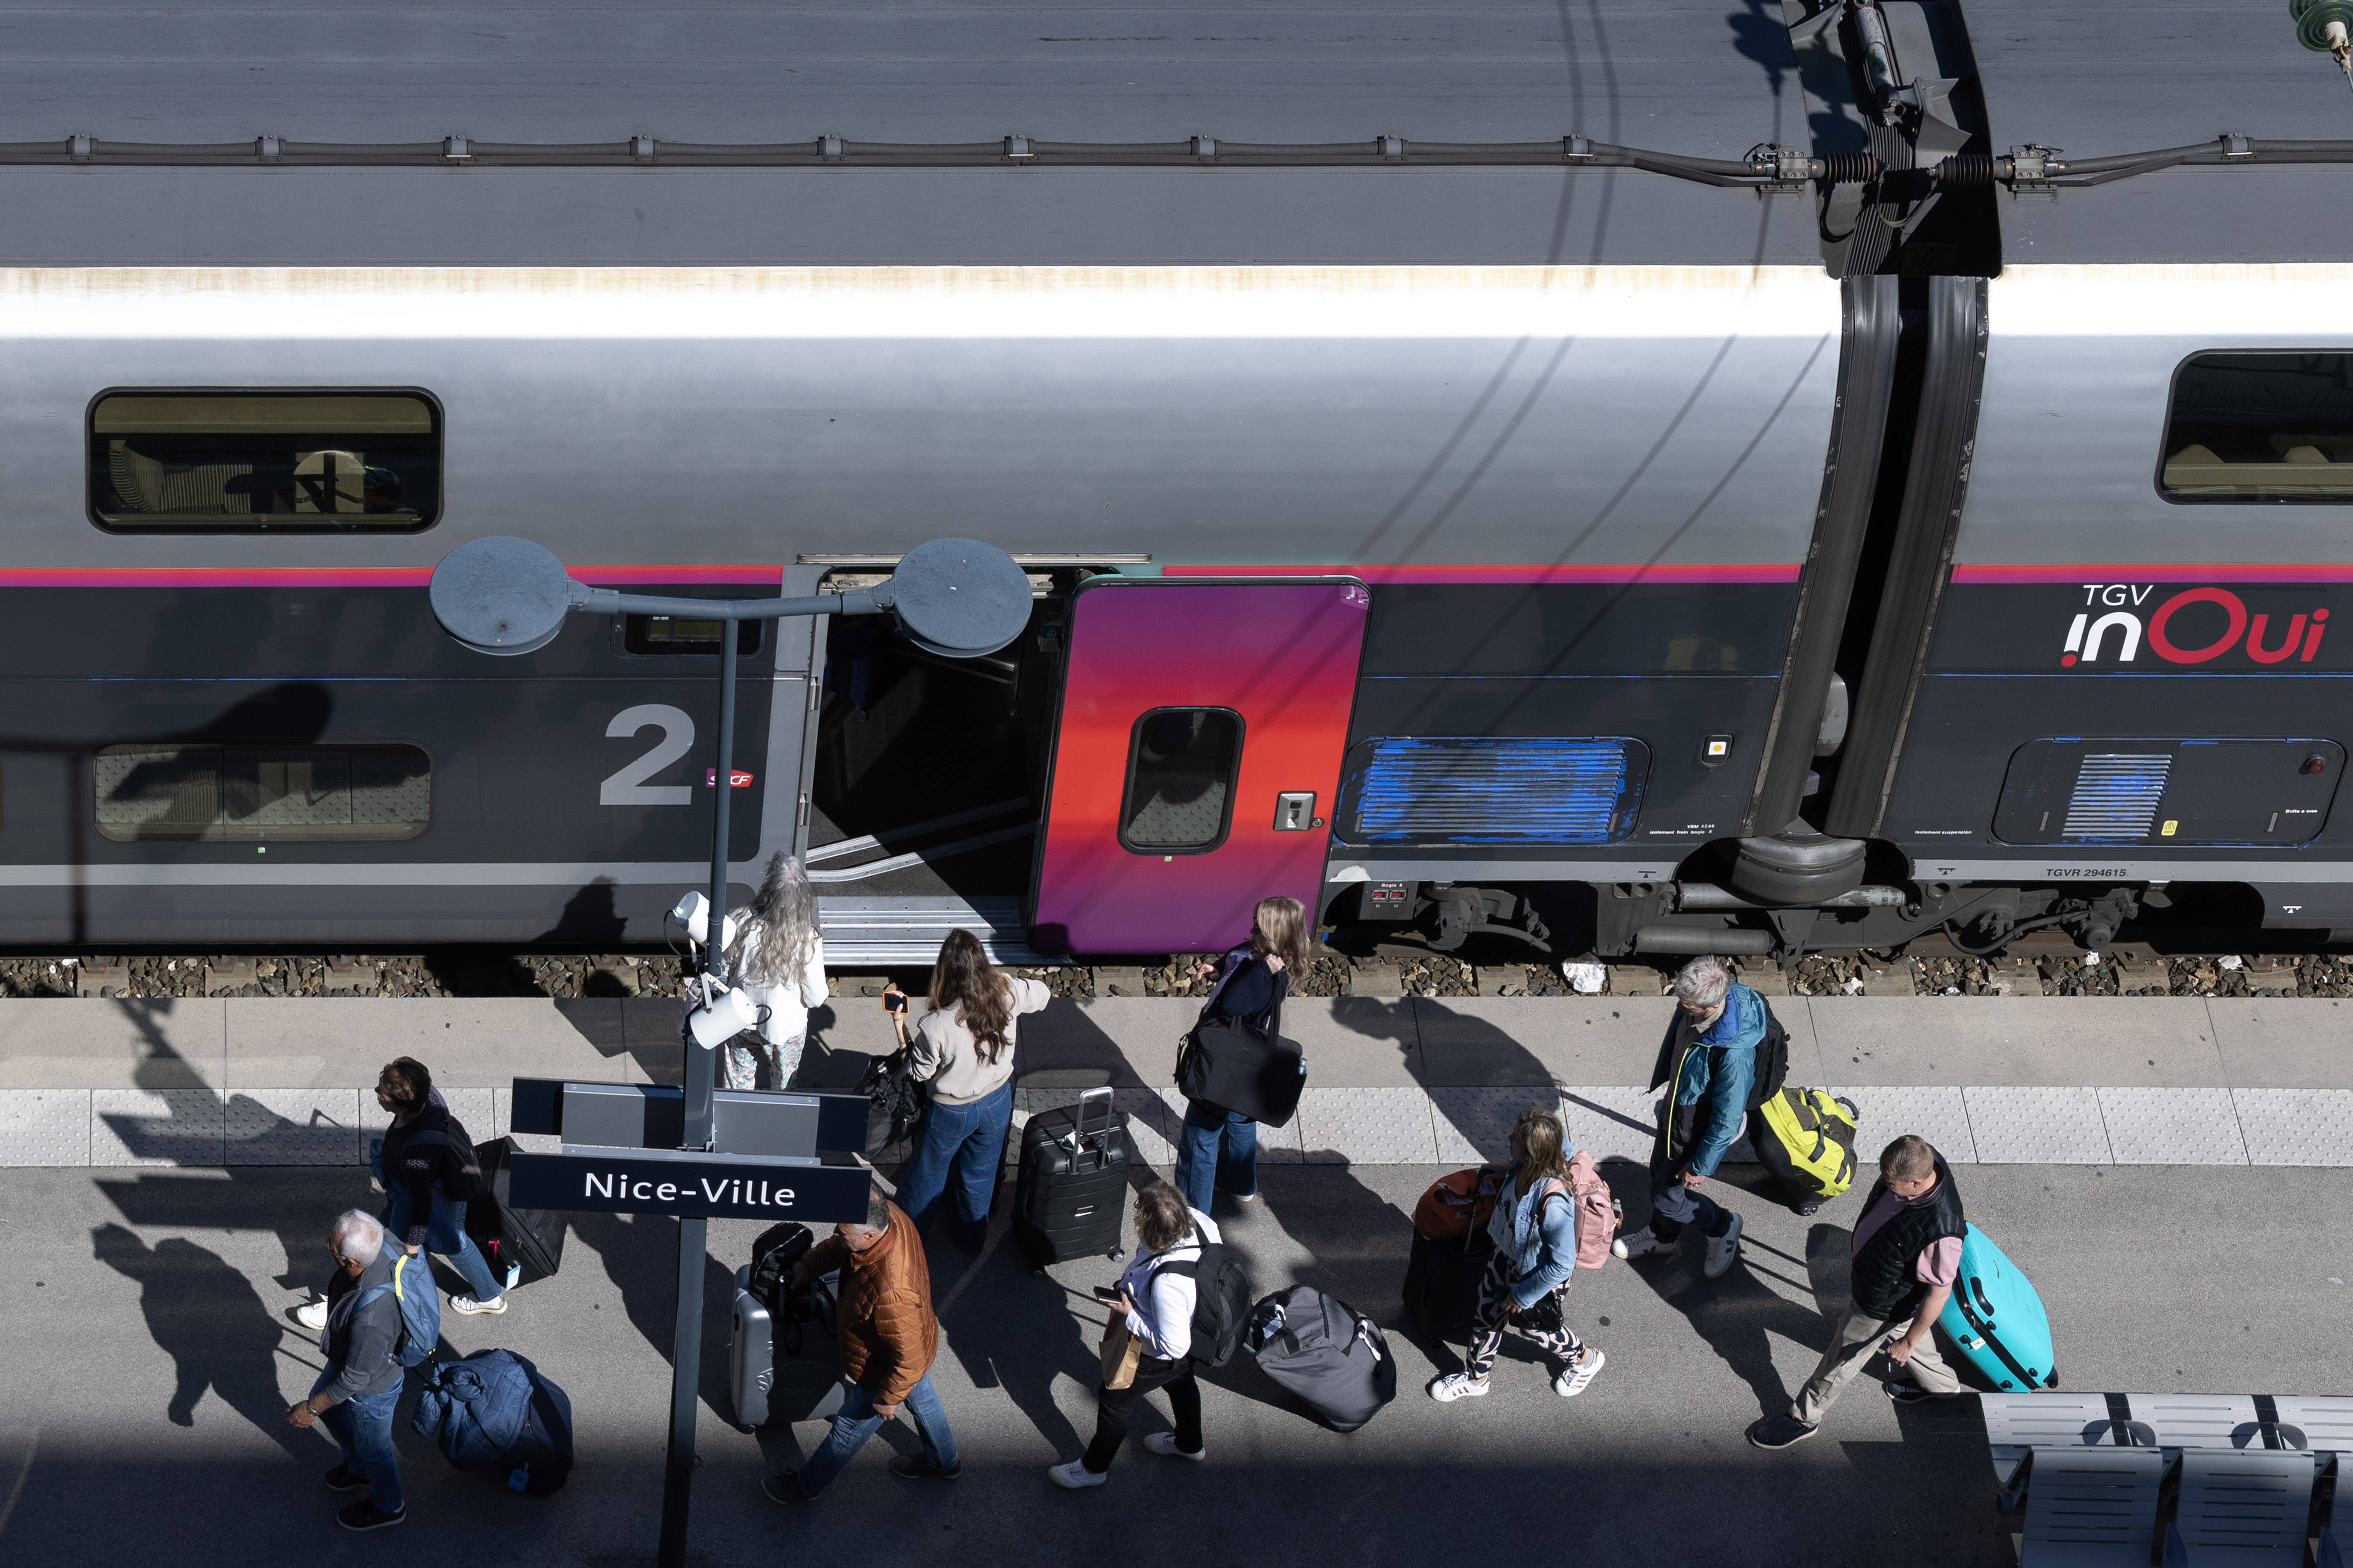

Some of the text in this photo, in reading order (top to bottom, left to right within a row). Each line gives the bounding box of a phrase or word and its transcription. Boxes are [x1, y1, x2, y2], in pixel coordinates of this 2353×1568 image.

[2083, 584, 2154, 606] TGV
[599, 704, 695, 806] 2
[708, 775, 750, 785] SCF
[585, 1172, 795, 1206] Nice-Ville
